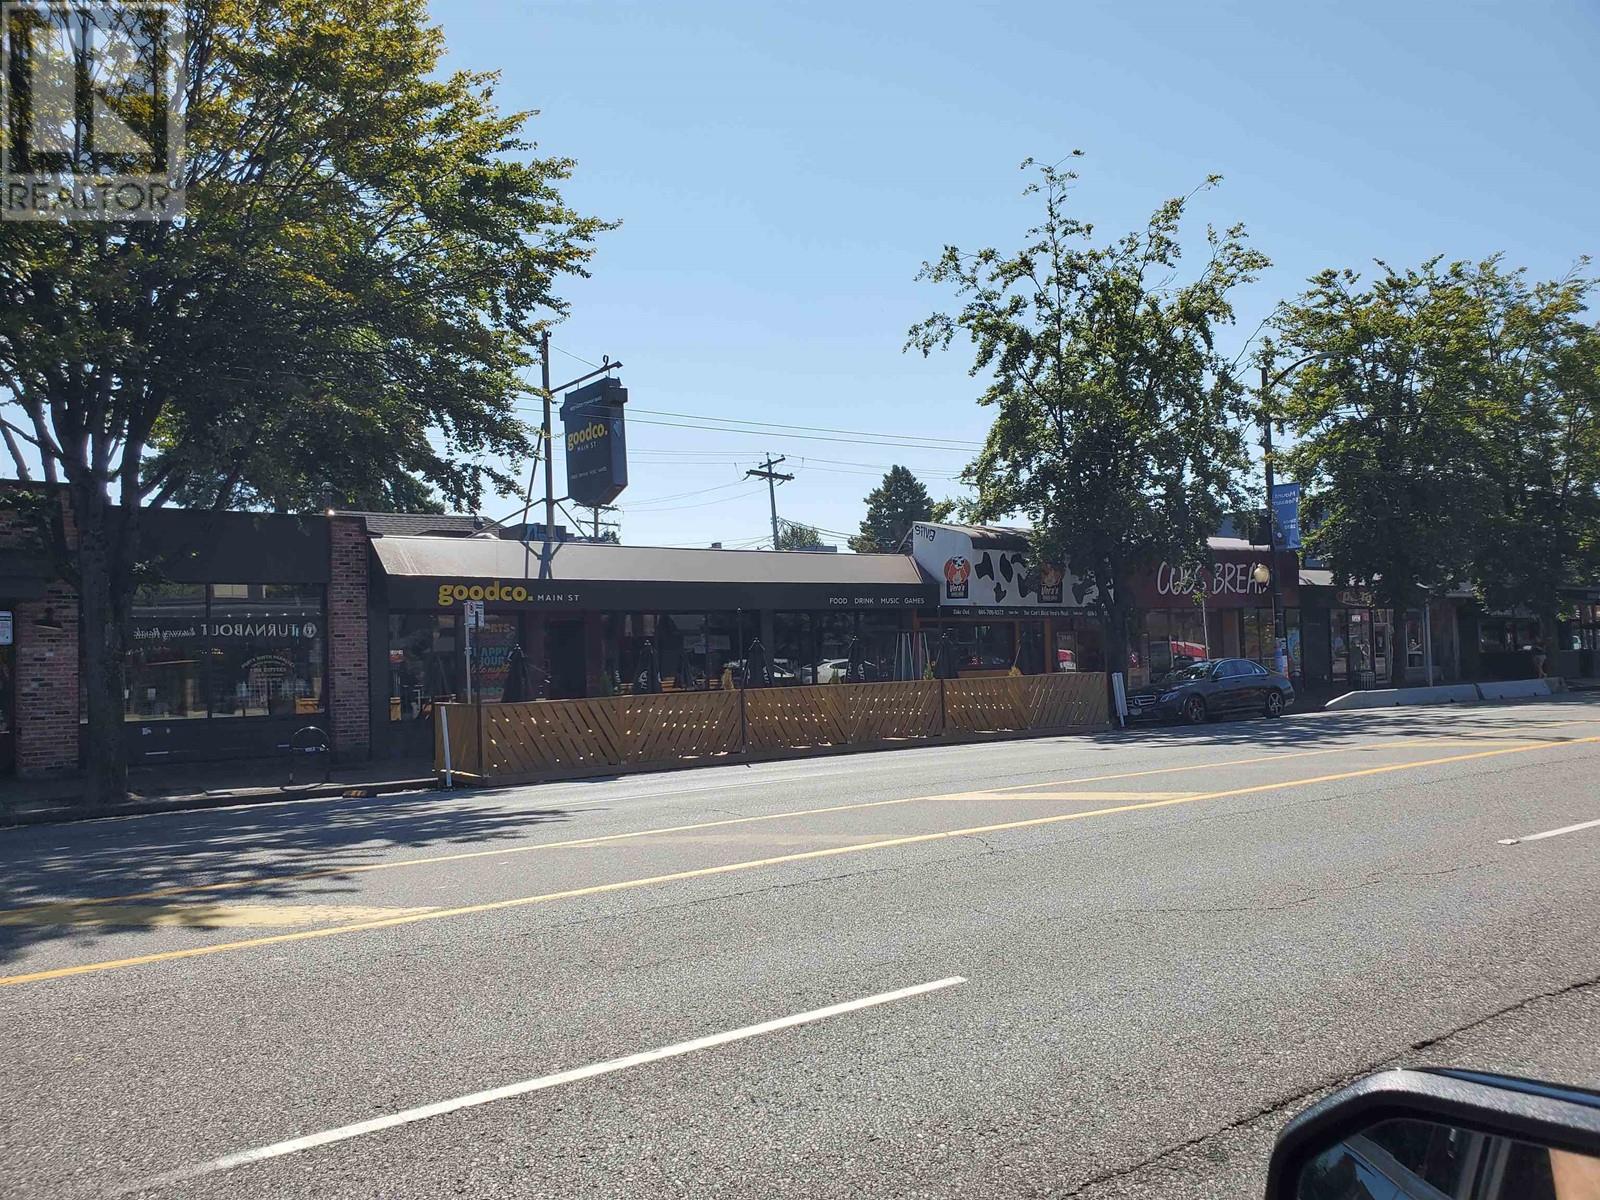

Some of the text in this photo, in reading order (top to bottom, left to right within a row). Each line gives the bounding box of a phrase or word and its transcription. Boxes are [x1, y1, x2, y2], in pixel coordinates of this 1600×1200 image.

[567, 422, 608, 452] goodco.
[438, 580, 534, 606] goodco.
[829, 597, 925, 605] FOOD DRINK MUSIC GAMES
